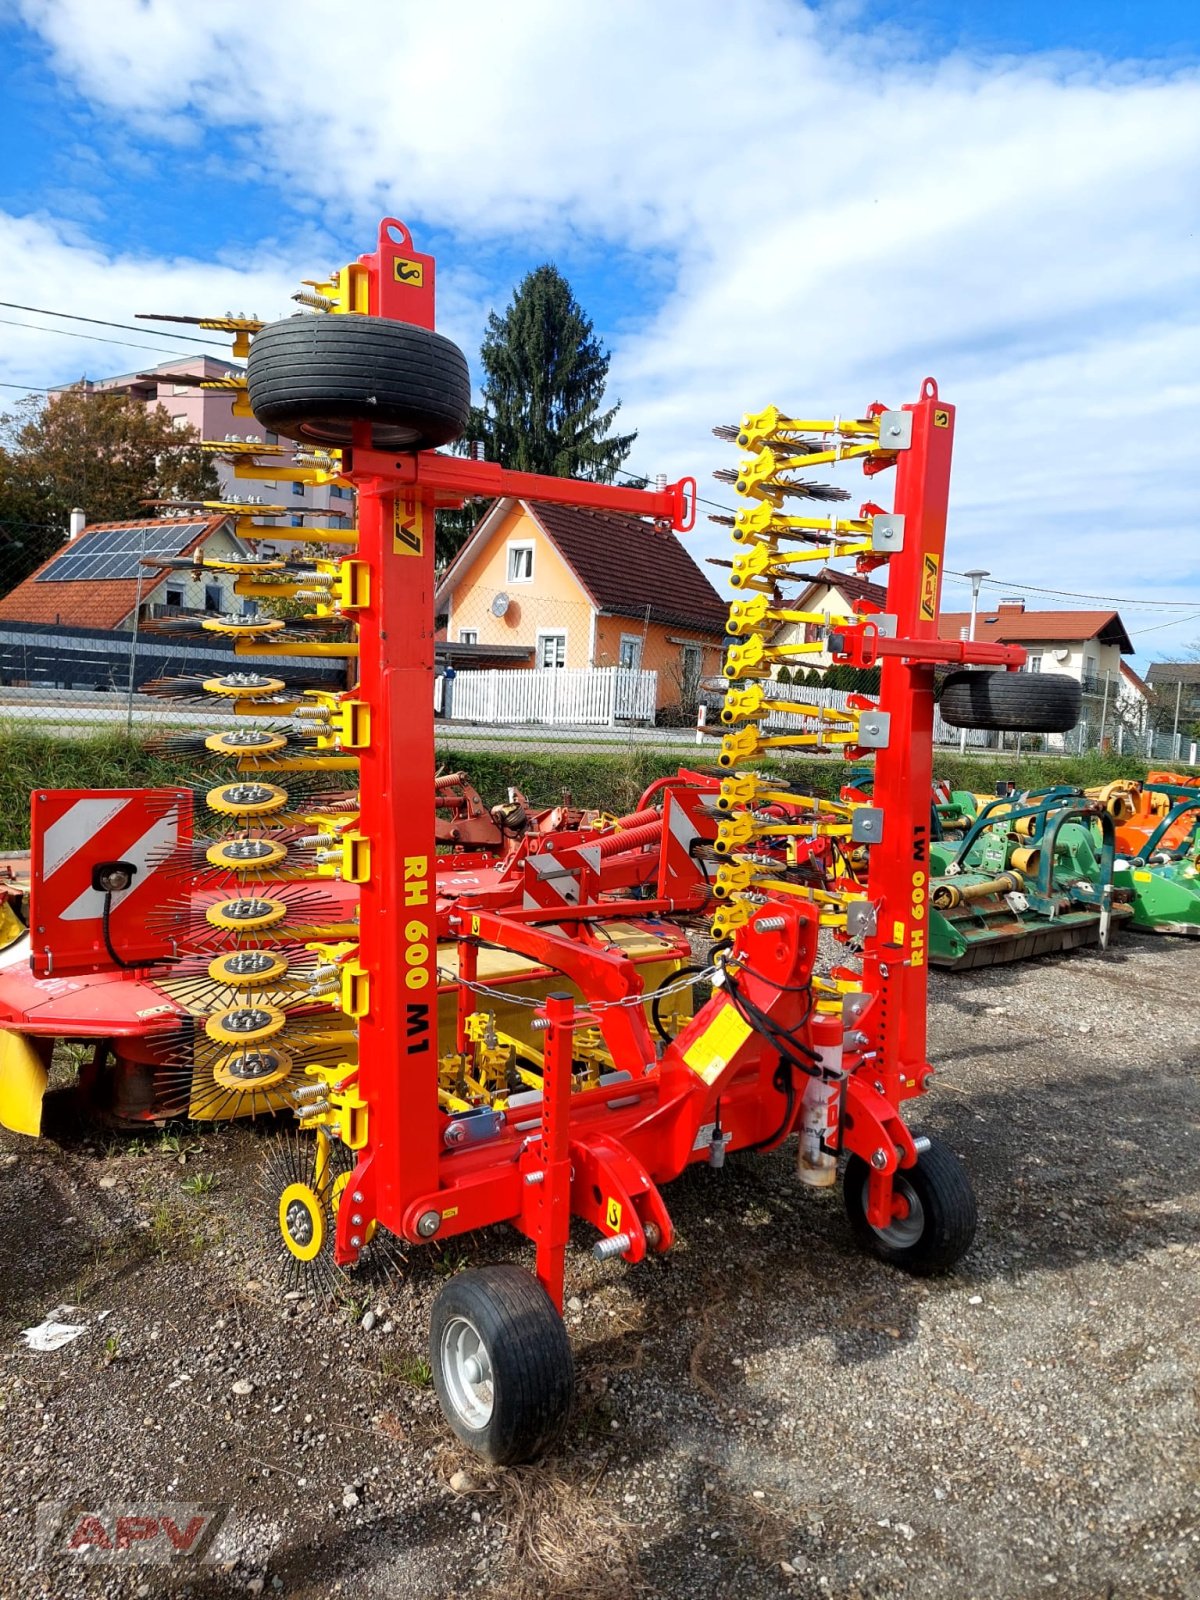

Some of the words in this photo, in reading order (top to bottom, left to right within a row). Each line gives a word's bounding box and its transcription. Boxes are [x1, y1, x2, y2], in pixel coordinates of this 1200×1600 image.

[398, 487, 419, 547] PV
[924, 558, 937, 614] APV
[913, 826, 925, 861] M1
[404, 855, 428, 907] RH
[911, 870, 925, 920] 600
[405, 920, 429, 990] 600
[911, 929, 924, 967] RH
[406, 1003, 429, 1055] M1
